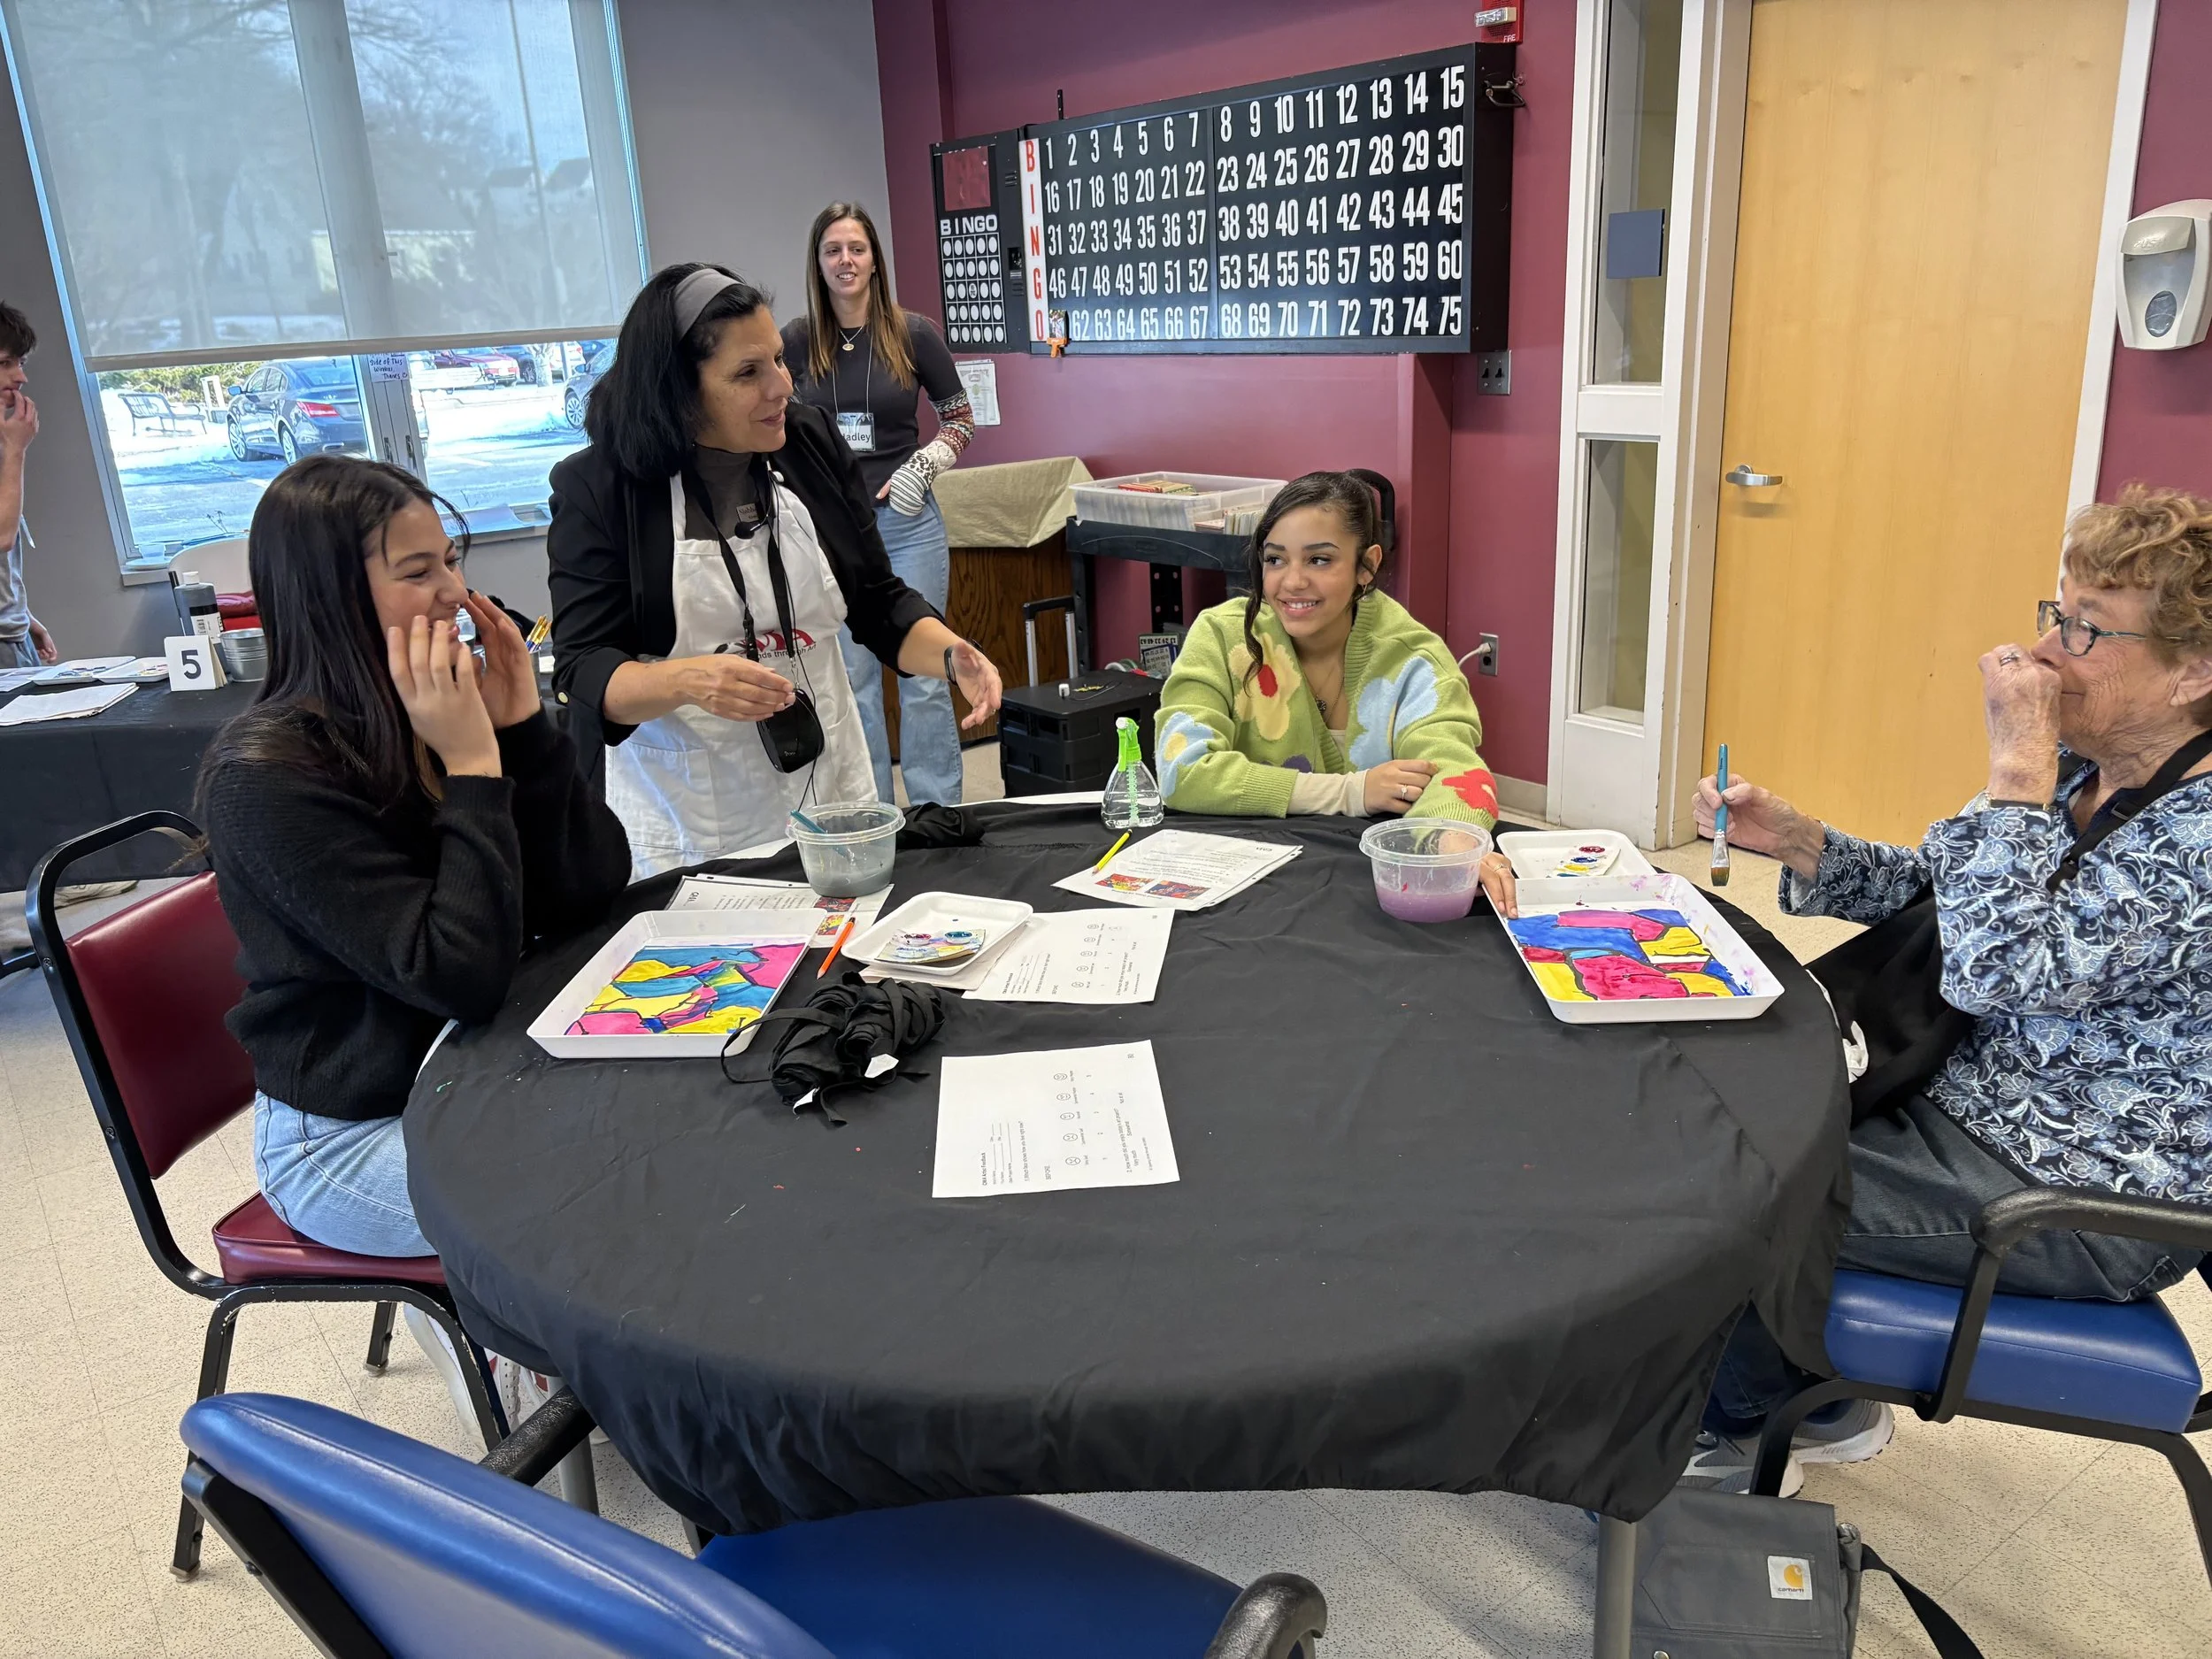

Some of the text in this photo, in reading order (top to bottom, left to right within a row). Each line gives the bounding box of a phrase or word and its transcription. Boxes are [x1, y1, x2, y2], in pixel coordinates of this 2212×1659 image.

[1045, 65, 1465, 170] 1 2 3 4 5 6 7 8 9 10 11 12 13 14 15
[1044, 124, 1464, 213] 16 17 18 19 20 21 22 23 24 25 26 27 28 29 30
[940, 214, 998, 236] BINGO
[1025, 140, 1044, 341] BINGO
[1047, 182, 1464, 256] 31 32 33 34 35 36 37 38 39 40 41 42 43 44 45
[1048, 239, 1463, 299] 46 47 48 49 50 51 52 53 54 55 56 57 58 59 60
[1072, 296, 1462, 341] 62 63 64 65 66 67 68 69 70 71 72 73 74 75
[843, 433, 871, 443] adley
[181, 649, 202, 680] 5
